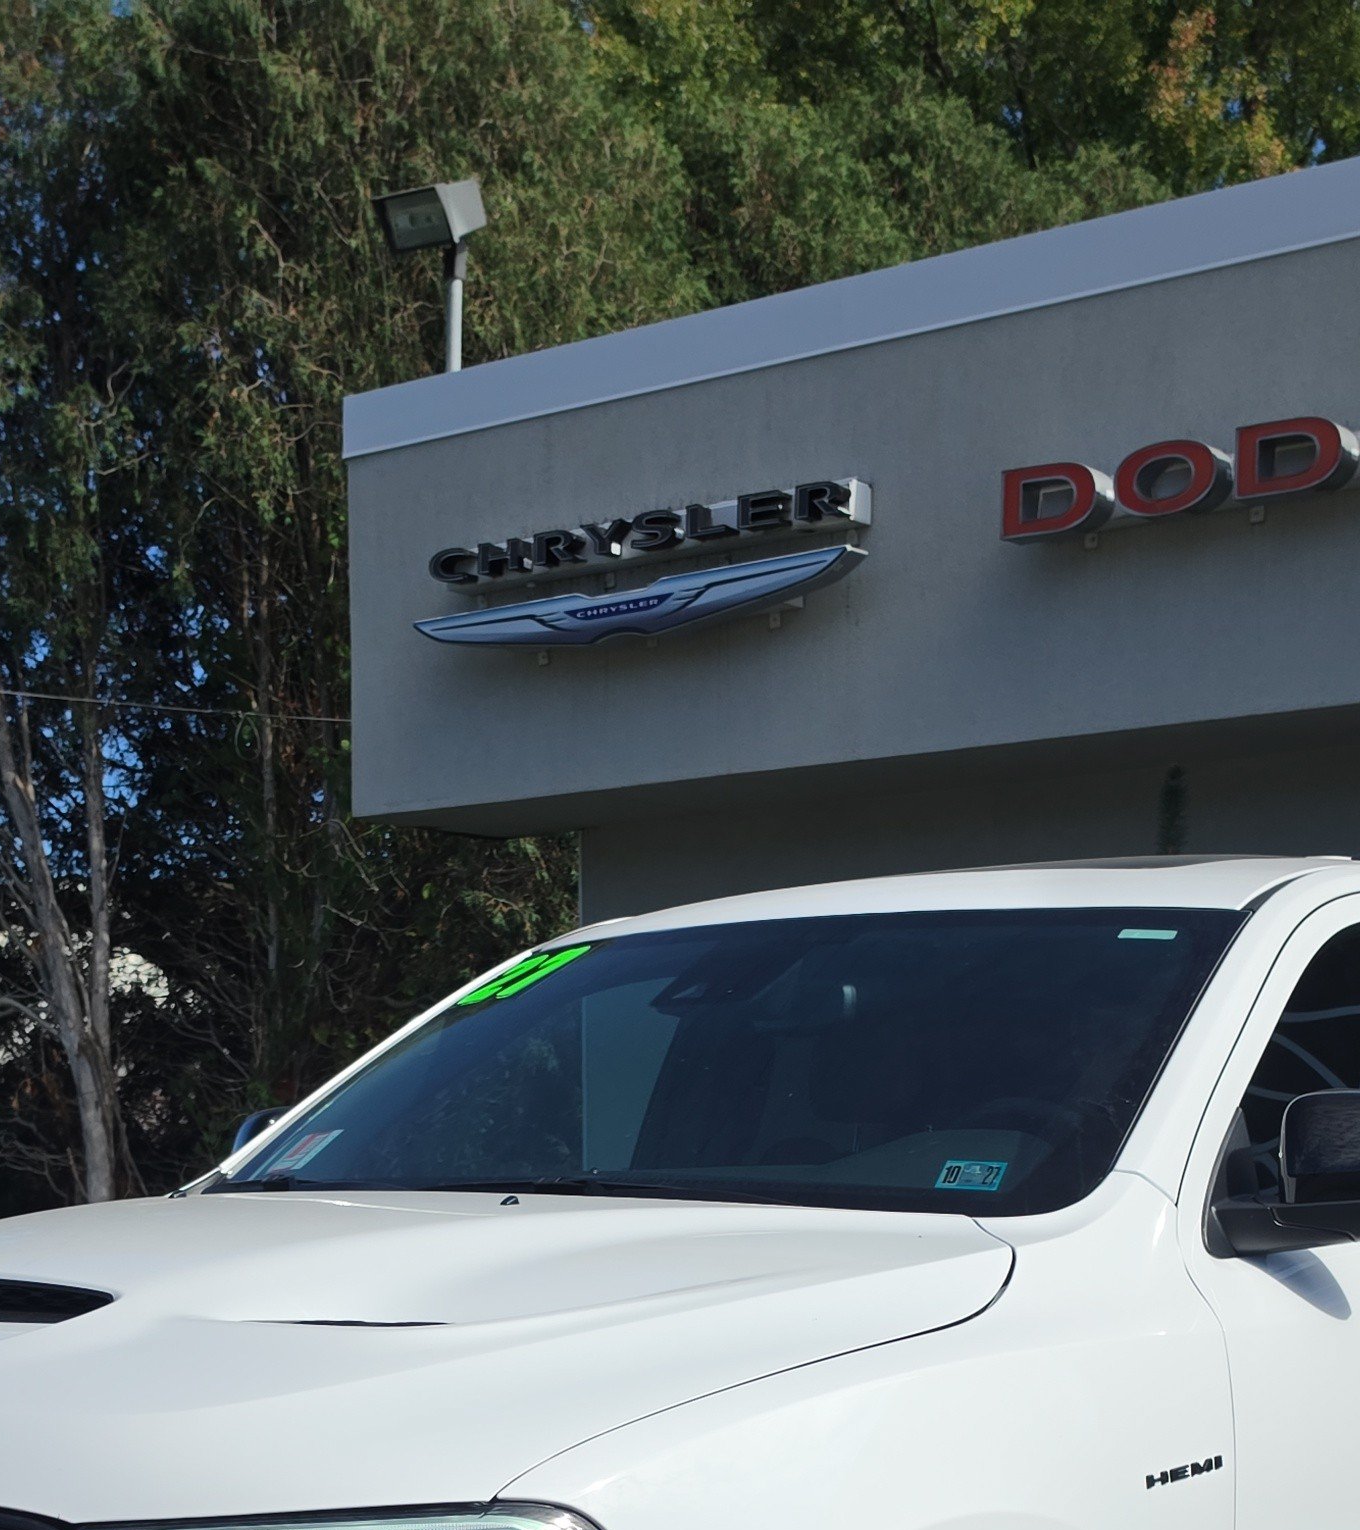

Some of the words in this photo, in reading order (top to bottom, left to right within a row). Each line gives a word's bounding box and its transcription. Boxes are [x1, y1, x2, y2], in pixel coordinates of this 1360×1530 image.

[429, 478, 854, 584] CHRYSLER
[576, 599, 659, 619] CHRYSLER
[942, 1165, 961, 1184] 10
[1145, 1454, 1223, 1490] HEMI
